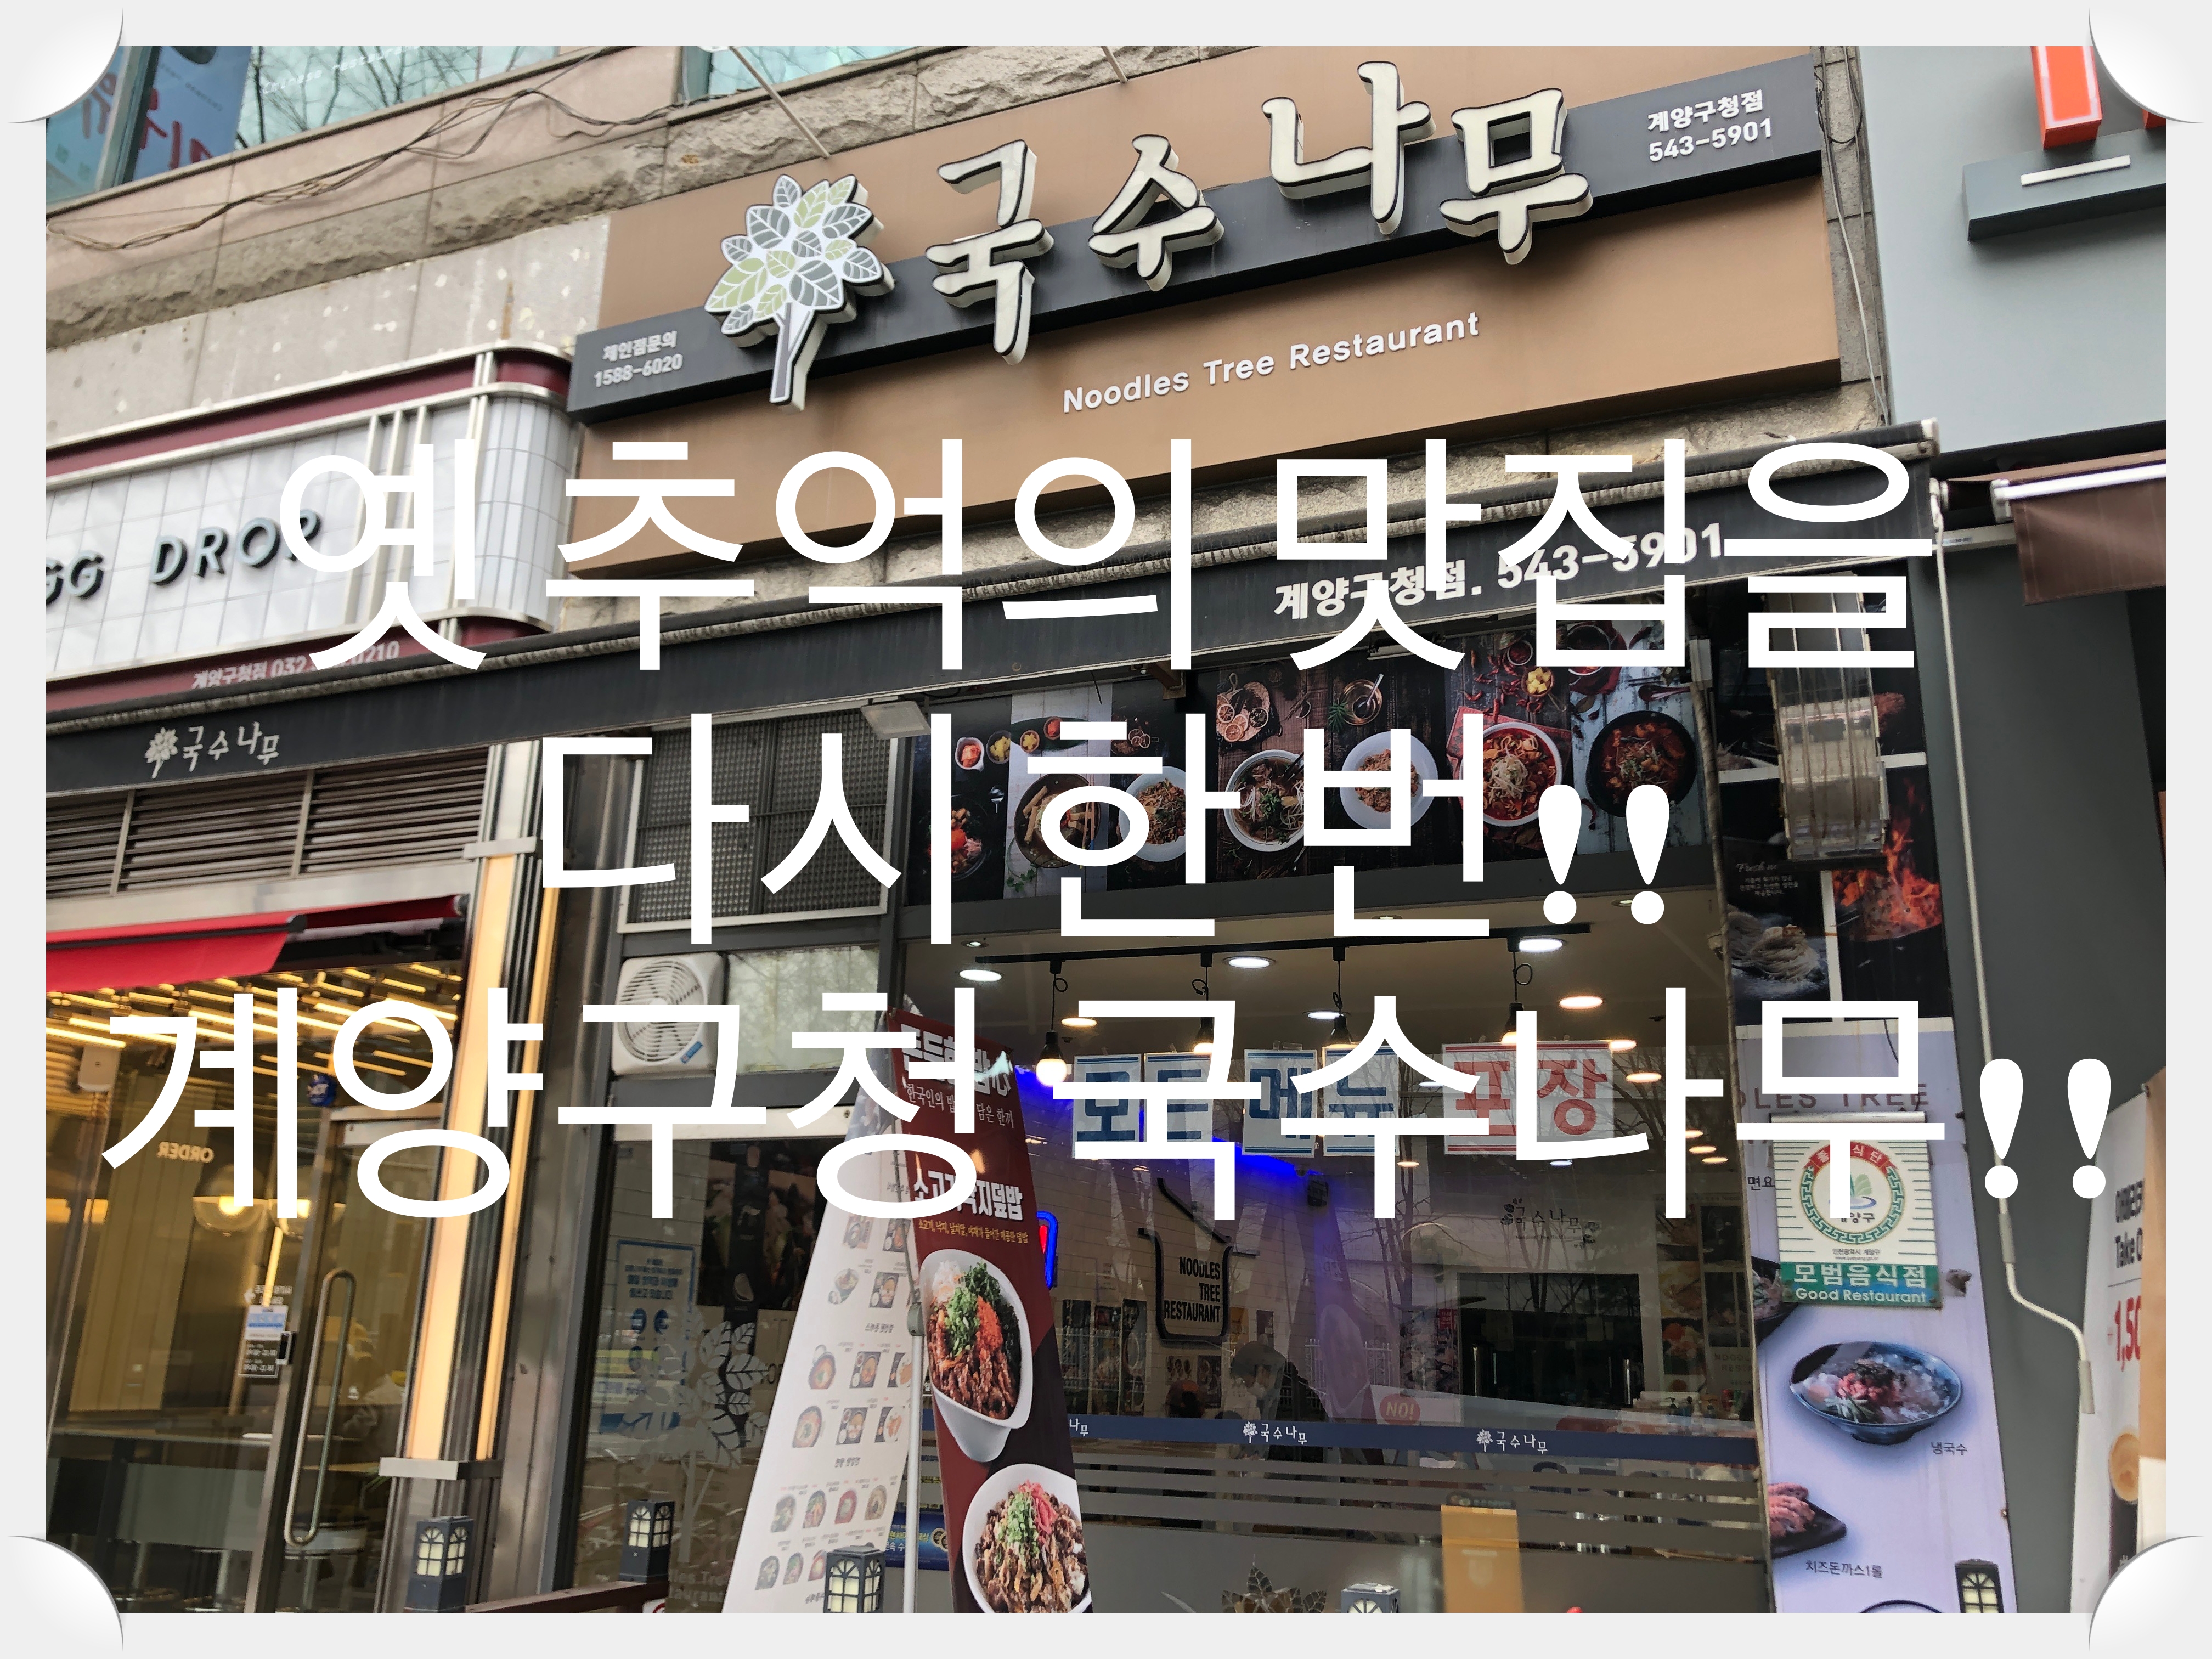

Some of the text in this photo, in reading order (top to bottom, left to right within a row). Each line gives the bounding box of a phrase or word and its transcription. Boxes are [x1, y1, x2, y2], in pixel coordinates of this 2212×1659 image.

[1647, 89, 1764, 133] 계양구청점
[1648, 117, 1772, 162] 543-5901
[926, 61, 1593, 364] 국수나무
[594, 353, 684, 388] 1588-6020
[1063, 312, 1480, 414] Noodles Tree Restaurant
[149, 508, 321, 586] DROP
[182, 721, 280, 771] 국수나무
[906, 1083, 944, 1111] 한국인의
[976, 1103, 994, 1123] 담은
[997, 1108, 1014, 1128] 한끼
[1839, 1212, 1875, 1223] 양구
[1179, 1256, 1220, 1280] NOODLES
[1793, 1263, 1927, 1288] 모범음식점
[1199, 1283, 1221, 1302] TREE
[1795, 1288, 1926, 1303] Good Restaurant
[1164, 1300, 1221, 1323] RESTAURANT
[1385, 1401, 1414, 1421] NO!
[1069, 1418, 1089, 1437] 나무
[1260, 1423, 1307, 1446] 국수나무
[1496, 1431, 1548, 1454] 국수나무
[1931, 1441, 1968, 1455] 냉국수
